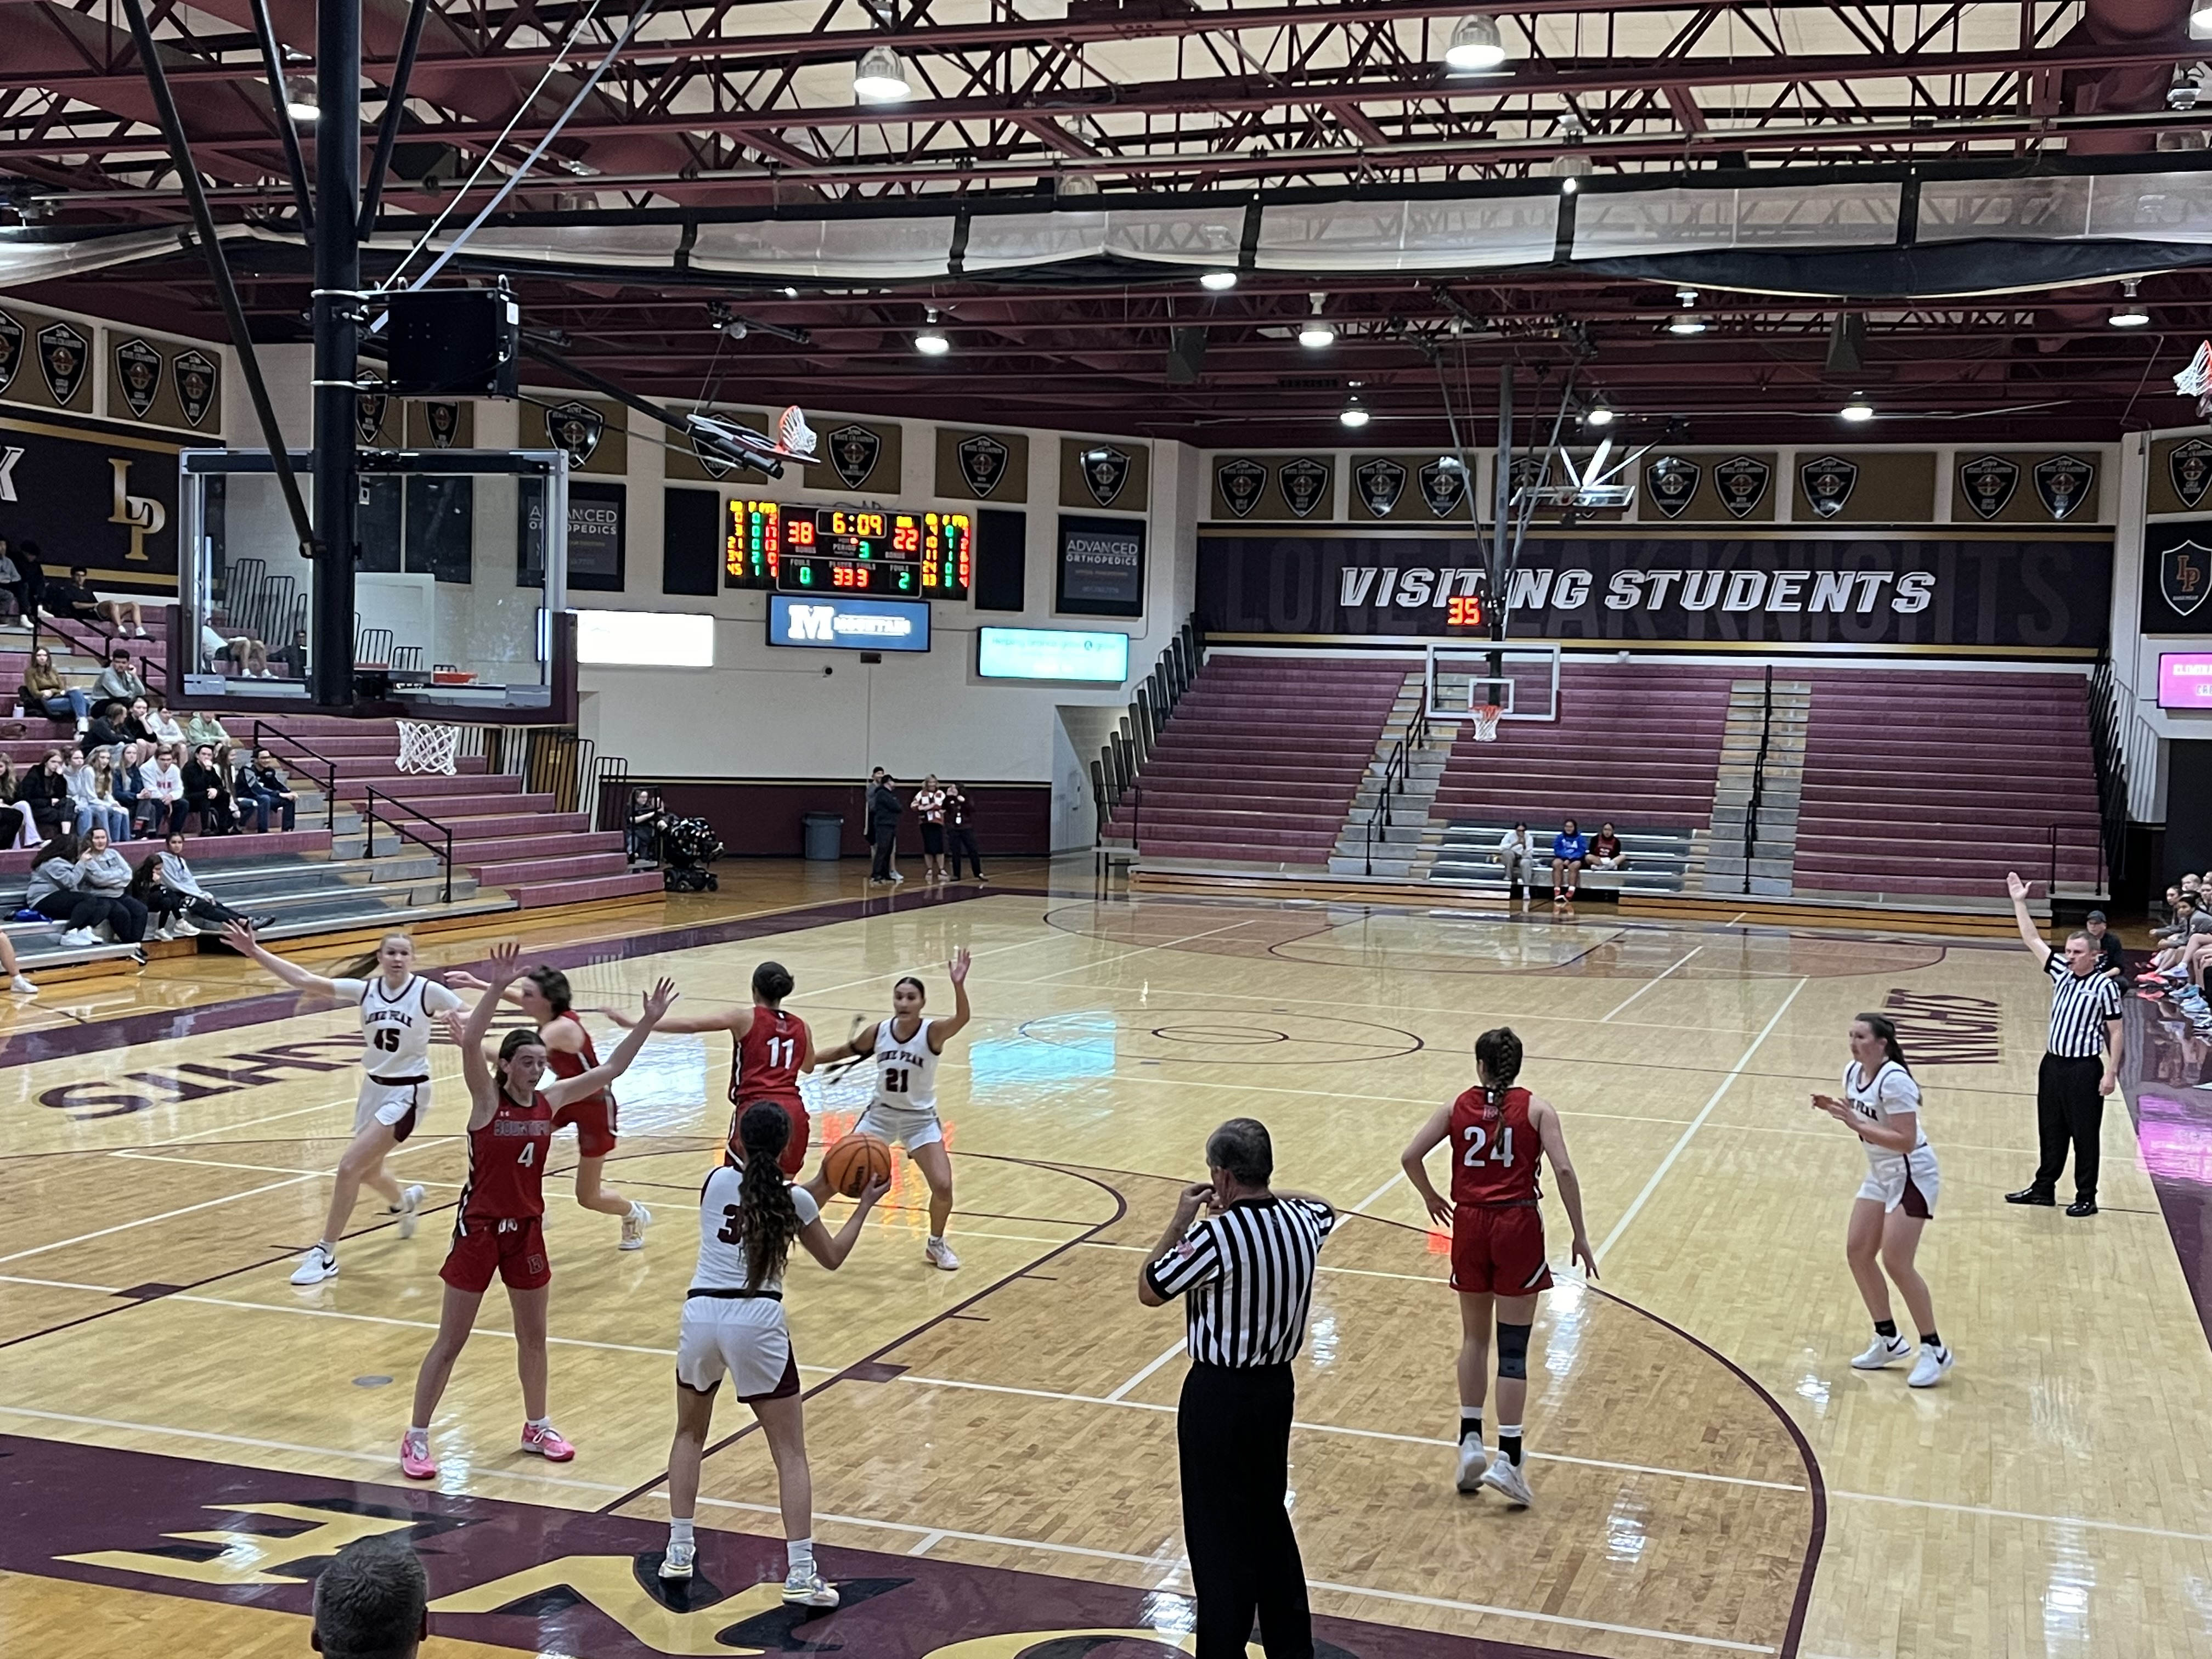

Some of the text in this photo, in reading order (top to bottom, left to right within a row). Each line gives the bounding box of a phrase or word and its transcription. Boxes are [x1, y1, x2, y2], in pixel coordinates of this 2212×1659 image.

[788, 521, 814, 544] 38
[832, 511, 882, 536] 6:09
[727, 535, 743, 549] 21
[859, 541, 869, 559] 3
[893, 528, 919, 551] 22
[1067, 539, 1138, 555] ADVANCED
[1065, 554, 1137, 566] ORTHOPEDICS
[800, 567, 811, 584] 0
[833, 567, 868, 588] 33 3
[898, 572, 910, 589] 2
[1604, 568, 1937, 613] STUDENTS
[788, 604, 835, 640] M
[1447, 596, 1480, 625] 35
[374, 1028, 400, 1053] 45
[767, 1036, 795, 1070] 11
[885, 1068, 909, 1093] 21
[517, 1142, 534, 1168] 4
[1464, 1126, 1514, 1168] 24
